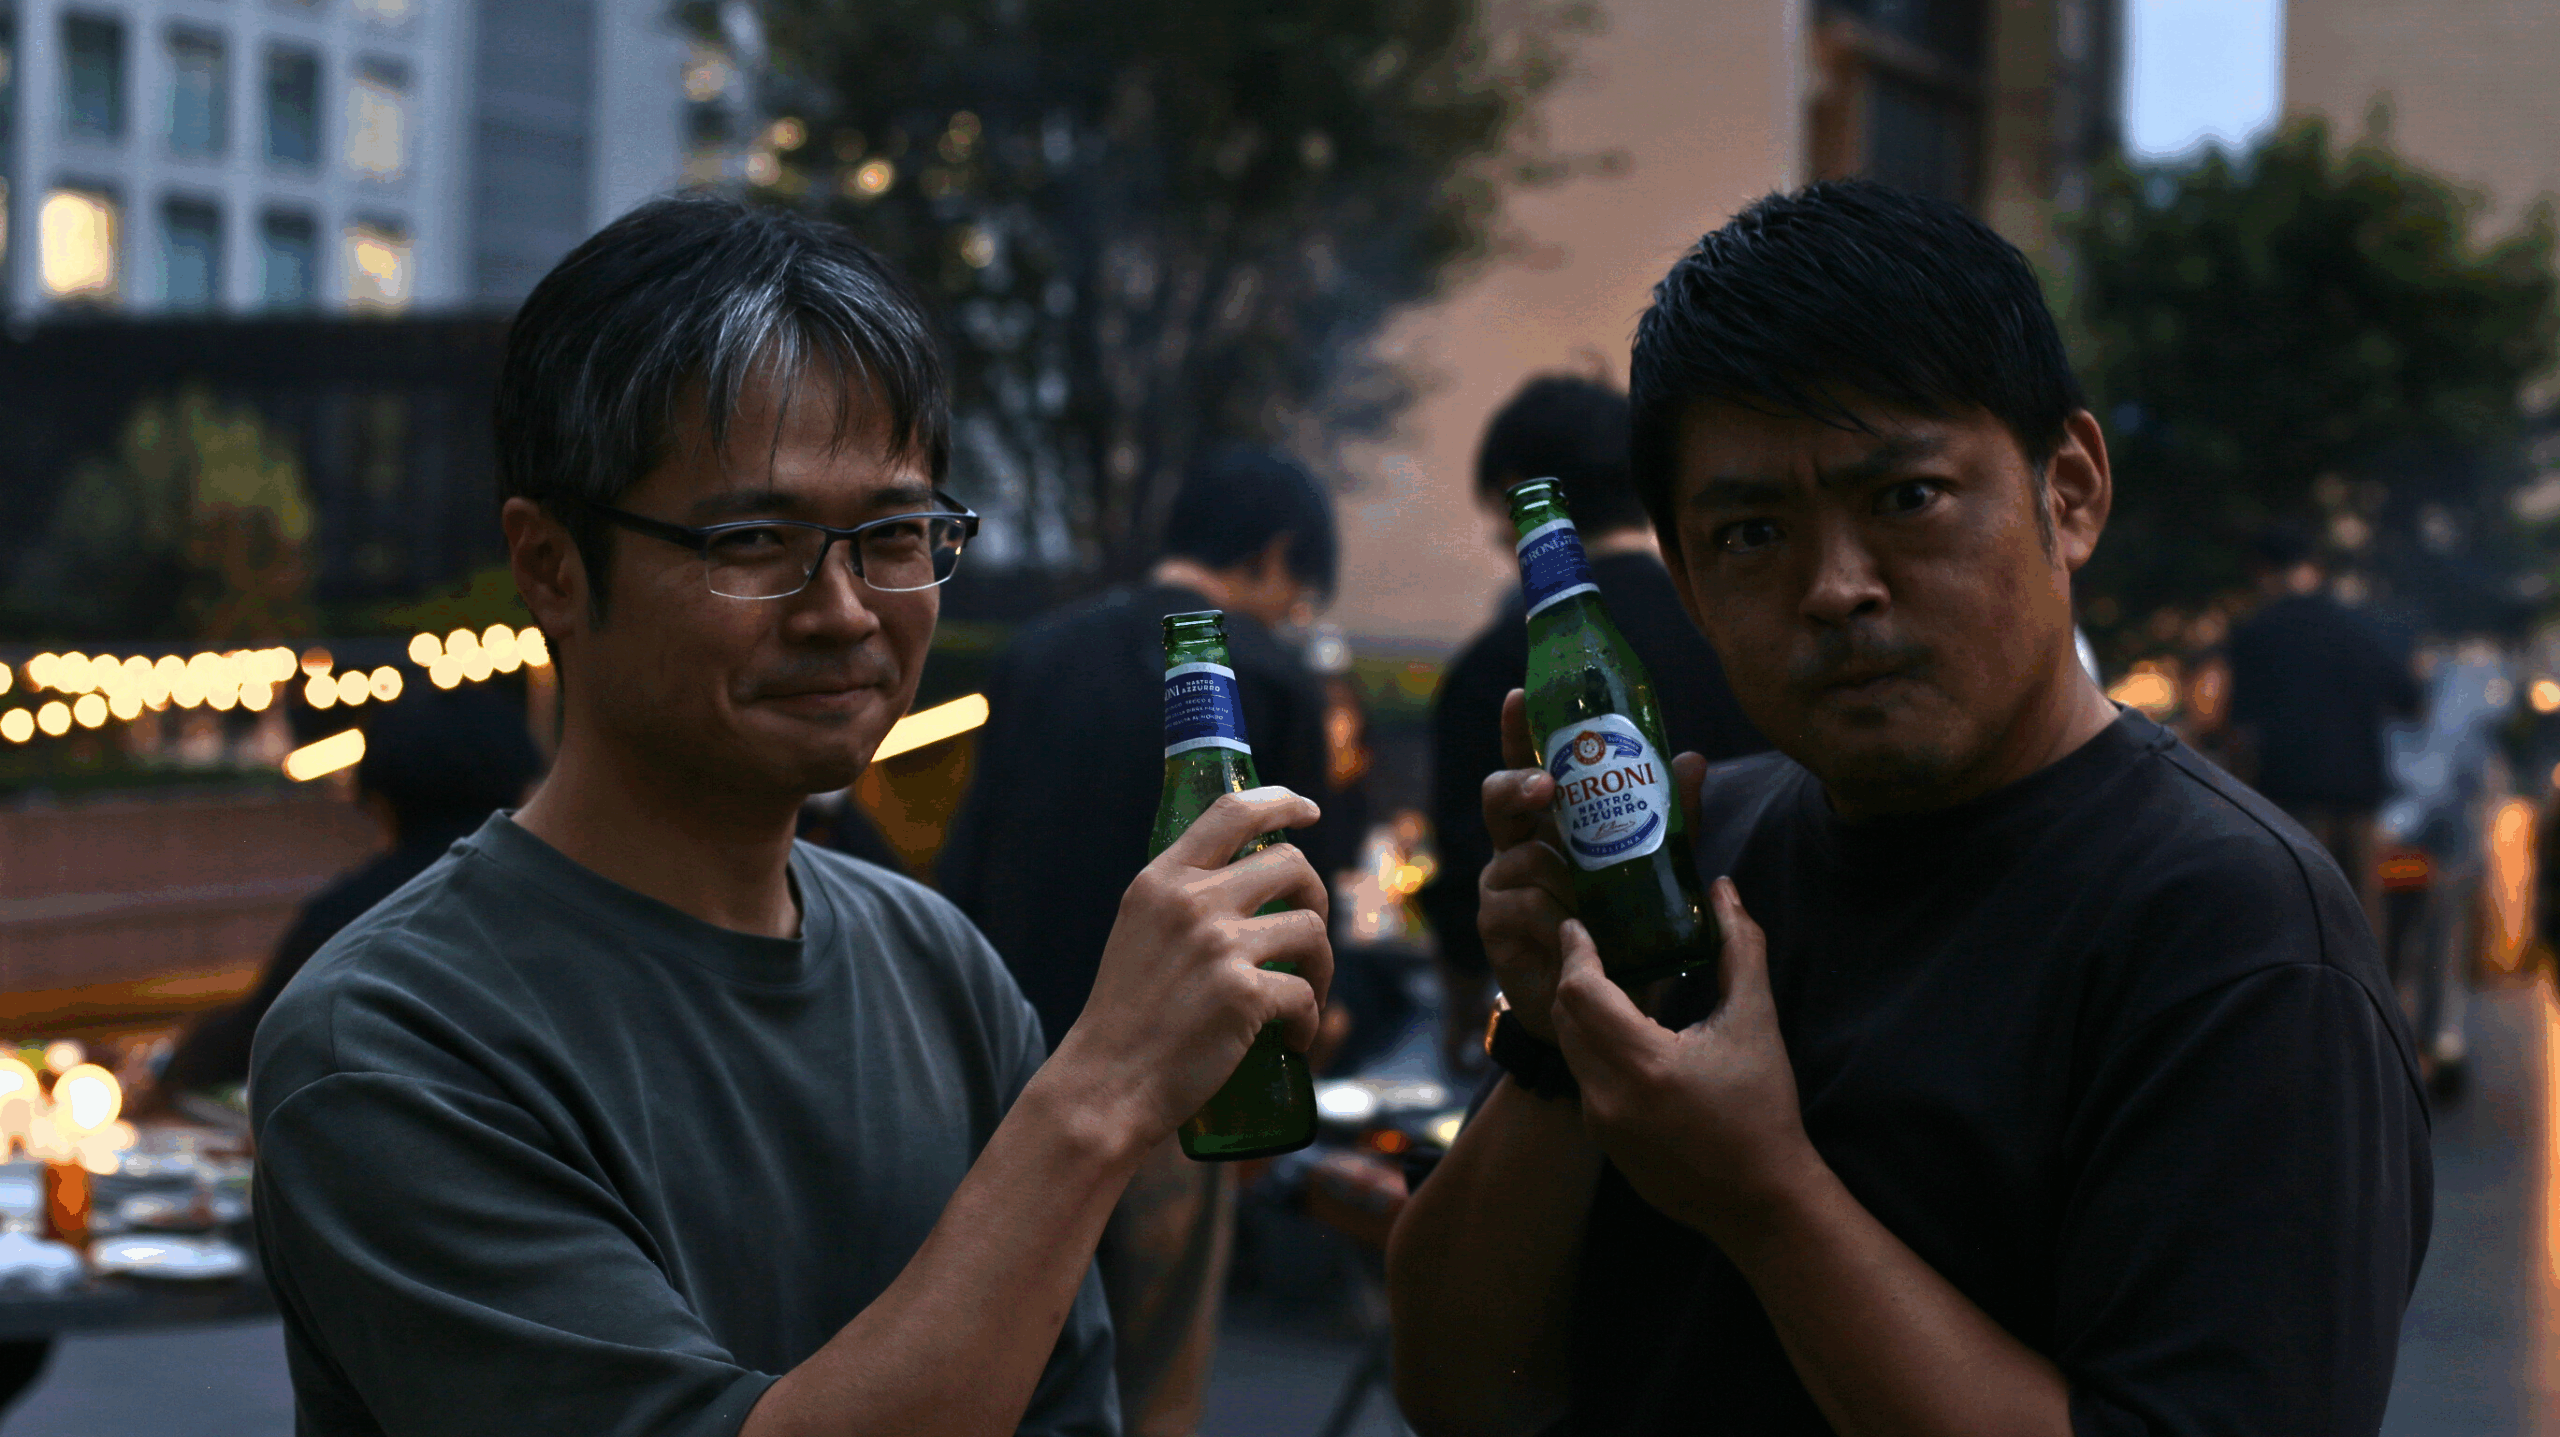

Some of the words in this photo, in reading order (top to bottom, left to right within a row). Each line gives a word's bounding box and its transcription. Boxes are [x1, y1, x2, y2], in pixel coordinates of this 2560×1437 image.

[1181, 685, 1221, 694] AZZURRO
[1554, 763, 1656, 811] PERONI
[1573, 800, 1648, 831] AZZURRO
[1578, 793, 1632, 815] NASTRO
